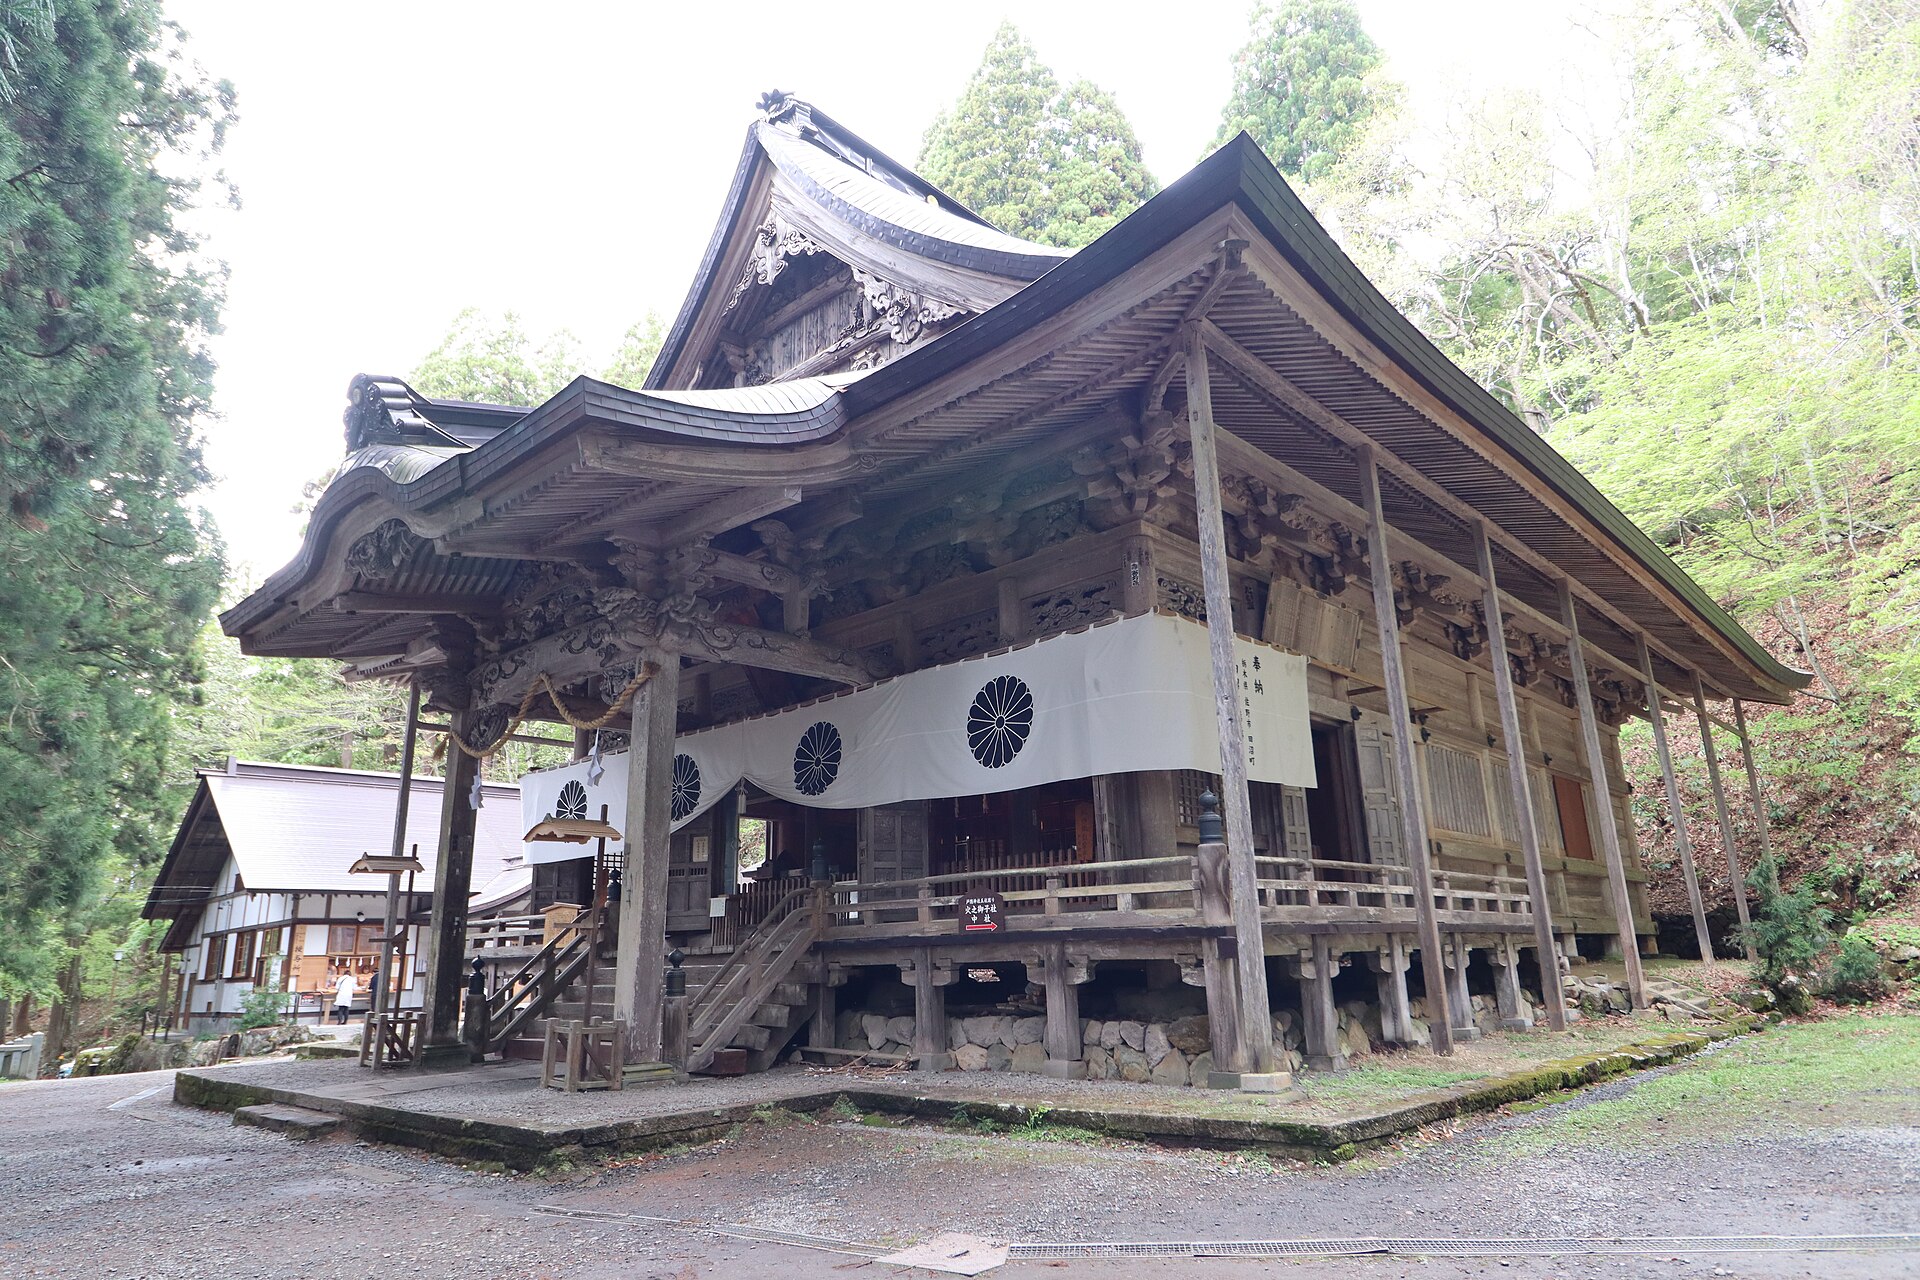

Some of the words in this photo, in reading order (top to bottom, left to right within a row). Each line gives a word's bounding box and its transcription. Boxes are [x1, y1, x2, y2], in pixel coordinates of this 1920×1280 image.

[1252, 655, 1264, 696] 奉納
[965, 903, 998, 915] 火之御子社
